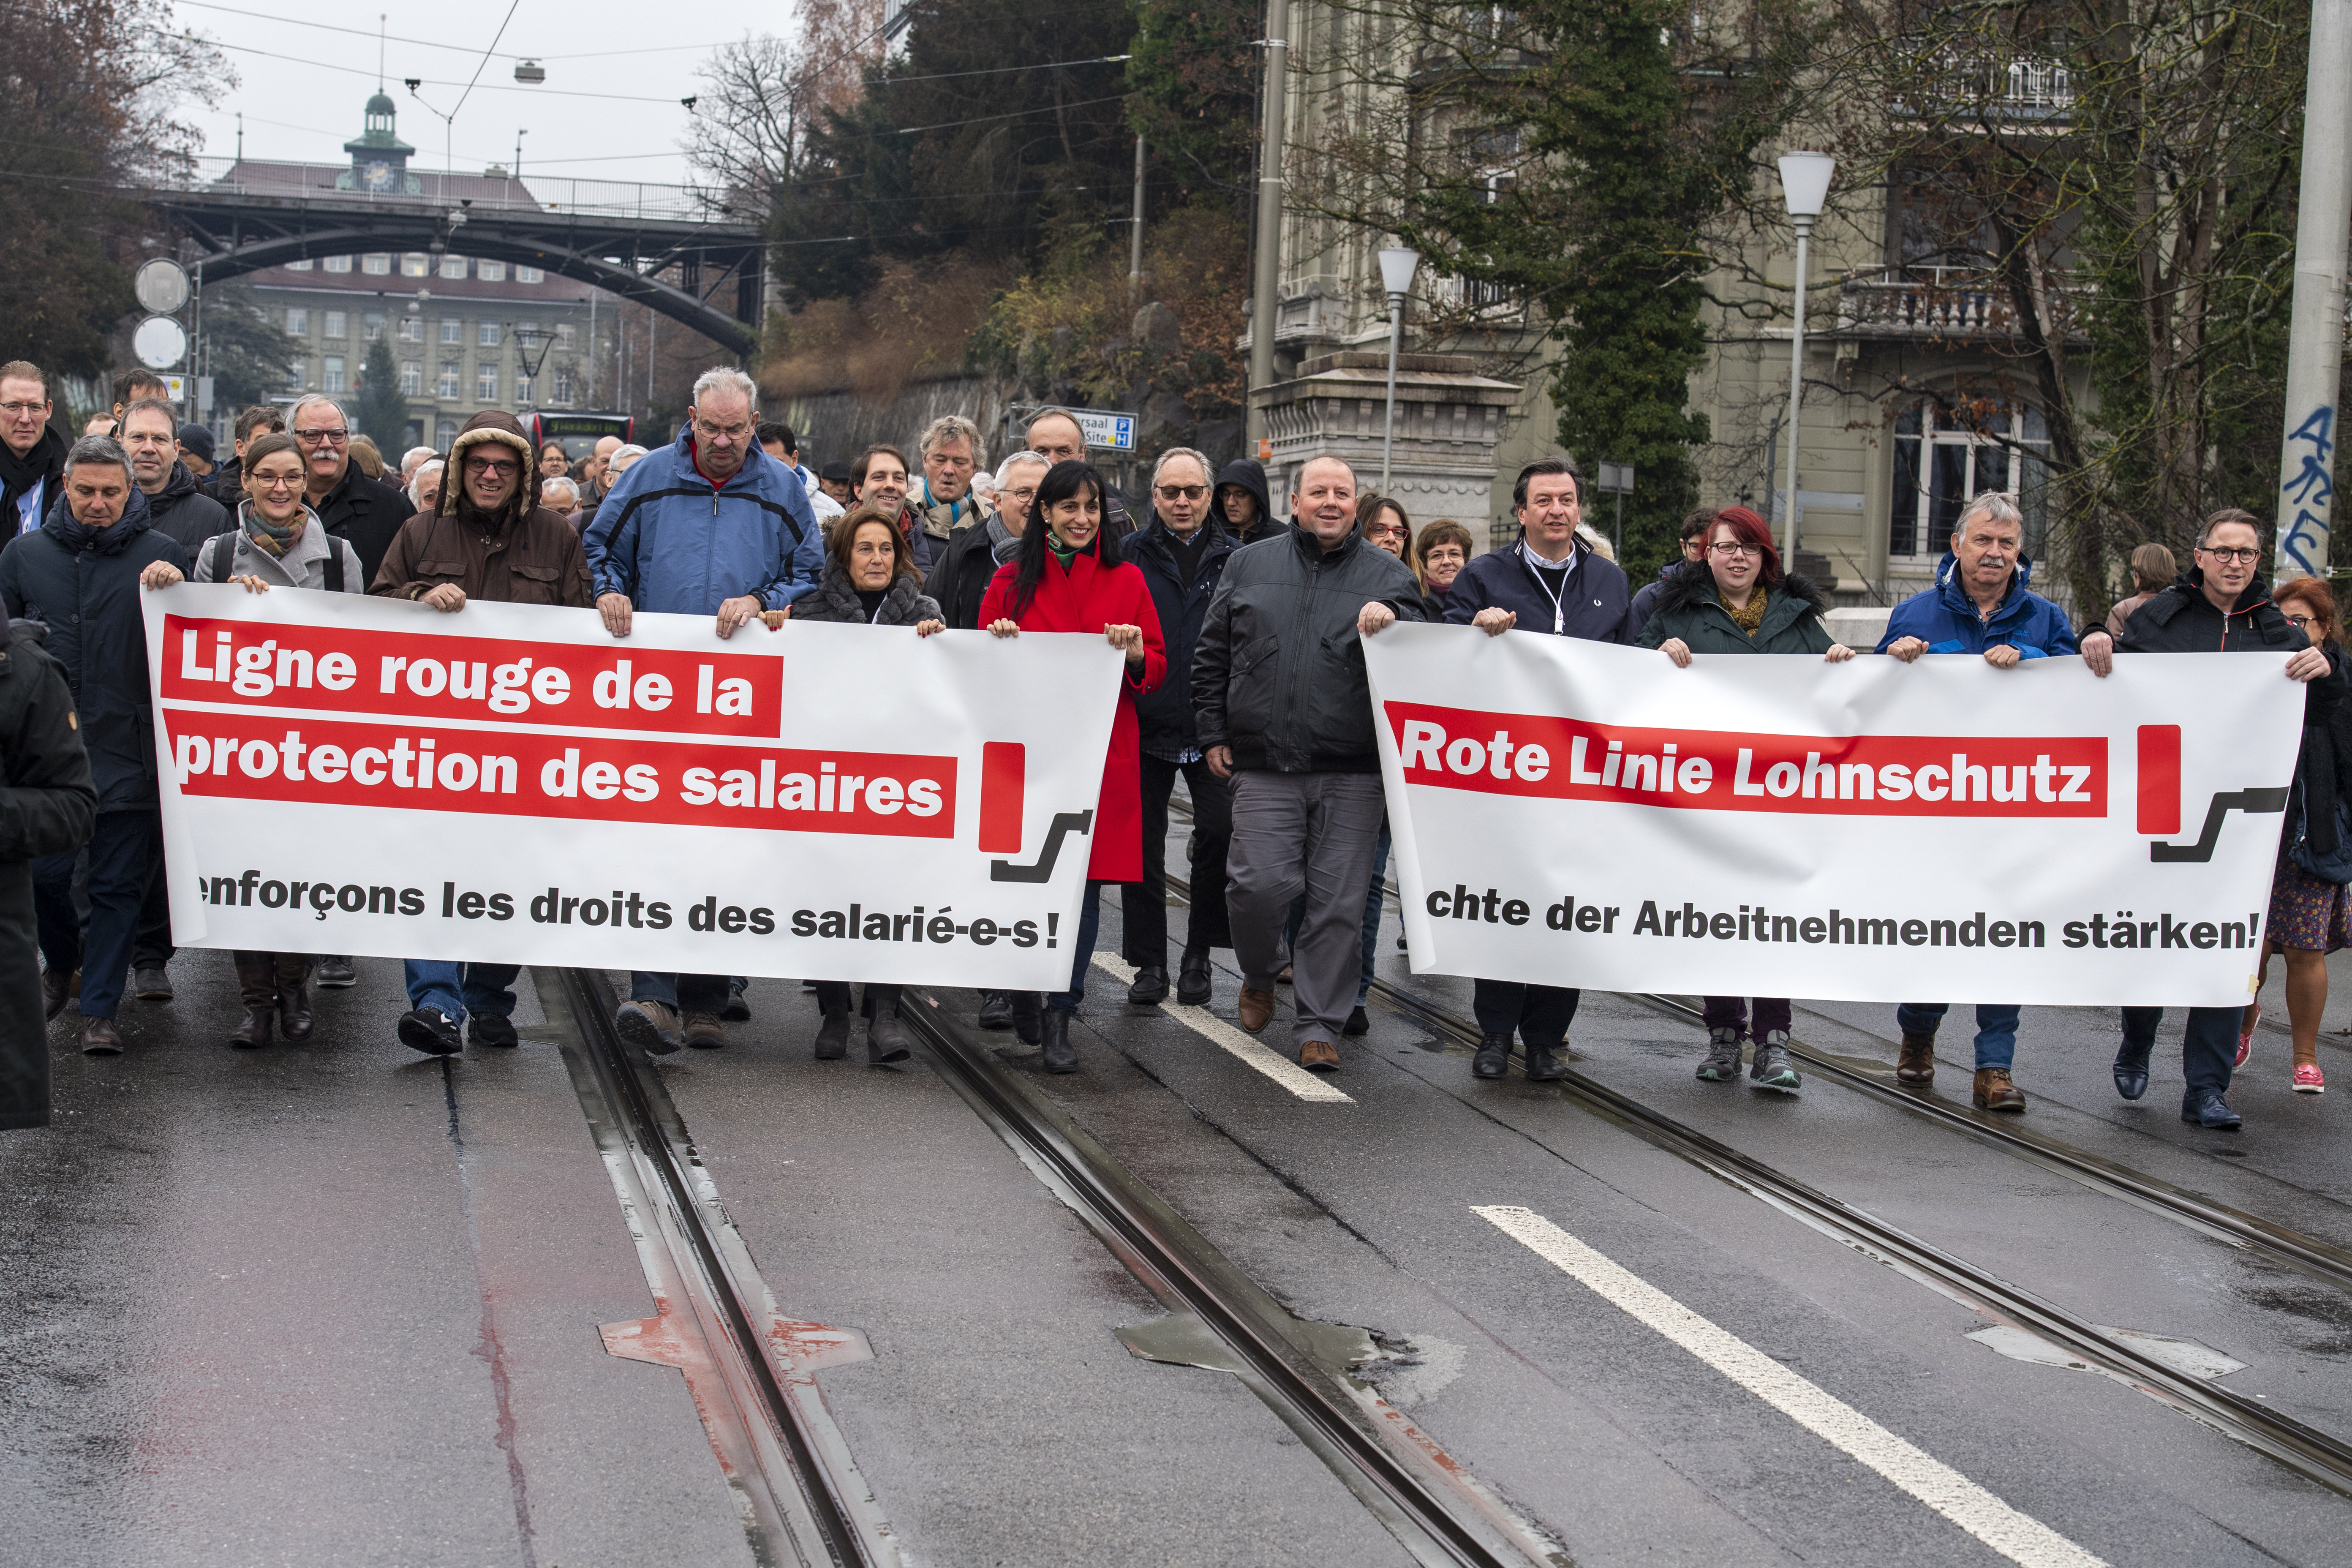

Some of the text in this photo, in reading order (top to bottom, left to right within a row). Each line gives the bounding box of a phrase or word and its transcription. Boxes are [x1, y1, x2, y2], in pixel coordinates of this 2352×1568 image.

[1078, 418, 1127, 431] rsaal P
[1086, 431, 1127, 445] Site H
[181, 629, 753, 716] Ligne rouge de la
[176, 731, 943, 817] protection des salaires
[1401, 719, 2091, 803] Rote Linie Lohnschutz
[442, 882, 514, 921] les
[530, 887, 672, 929] droits
[688, 896, 775, 935] des
[1426, 884, 2259, 949] chte der Arbeitnehmenden stärken!
